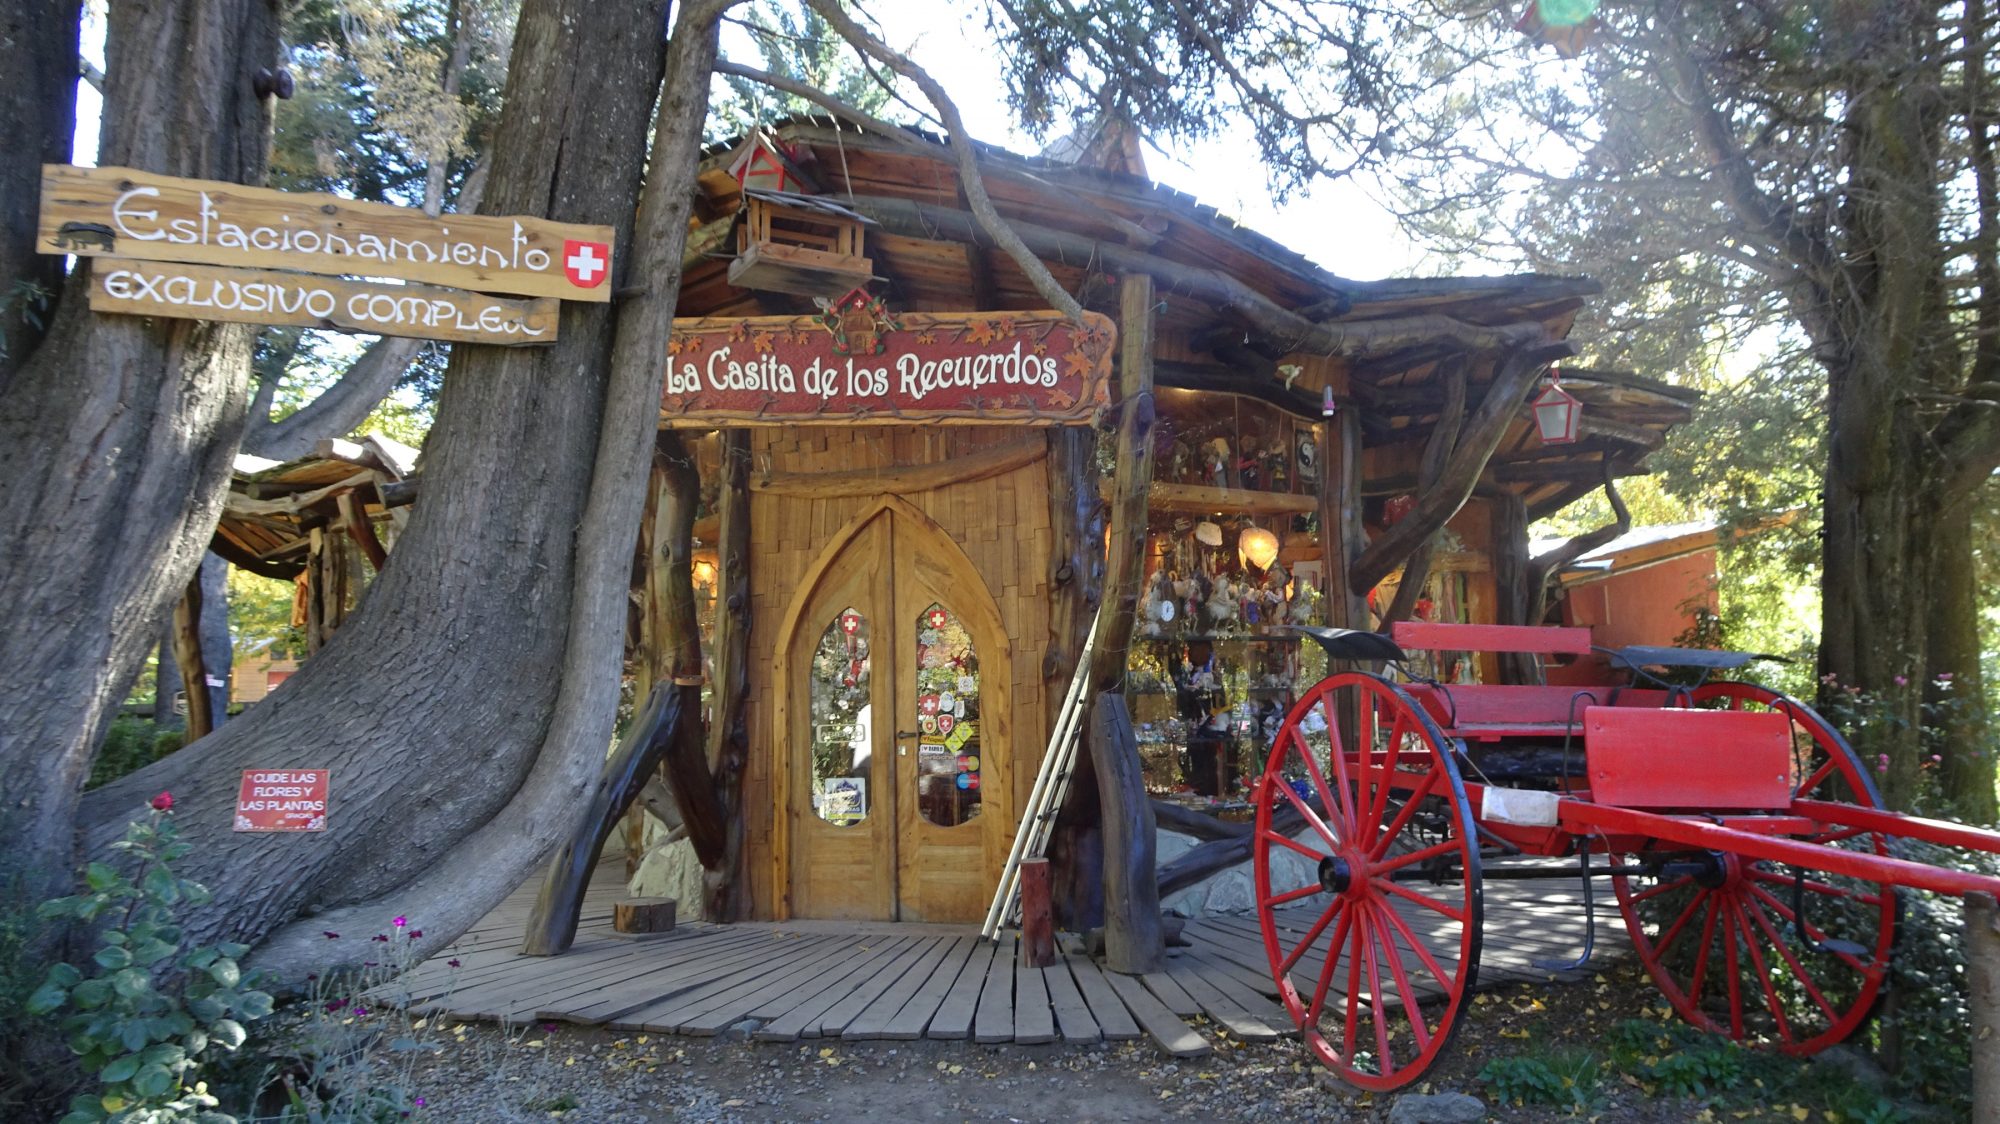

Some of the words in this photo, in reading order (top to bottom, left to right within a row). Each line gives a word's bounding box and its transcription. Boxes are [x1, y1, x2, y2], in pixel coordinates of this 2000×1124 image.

[113, 187, 551, 272] Estacionamiento
[104, 270, 336, 318] EXCLUSIVO
[667, 356, 701, 394] La
[707, 346, 796, 393] Casita
[803, 357, 838, 399] de
[847, 358, 889, 397] los
[896, 341, 1058, 399] Recuerdos
[253, 773, 289, 783] CUIDE
[291, 773, 317, 783] LAS
[253, 787, 301, 797] FLORES
[303, 787, 314, 797] Y
[240, 801, 265, 811] LAS
[267, 801, 324, 811] PLANTAS
